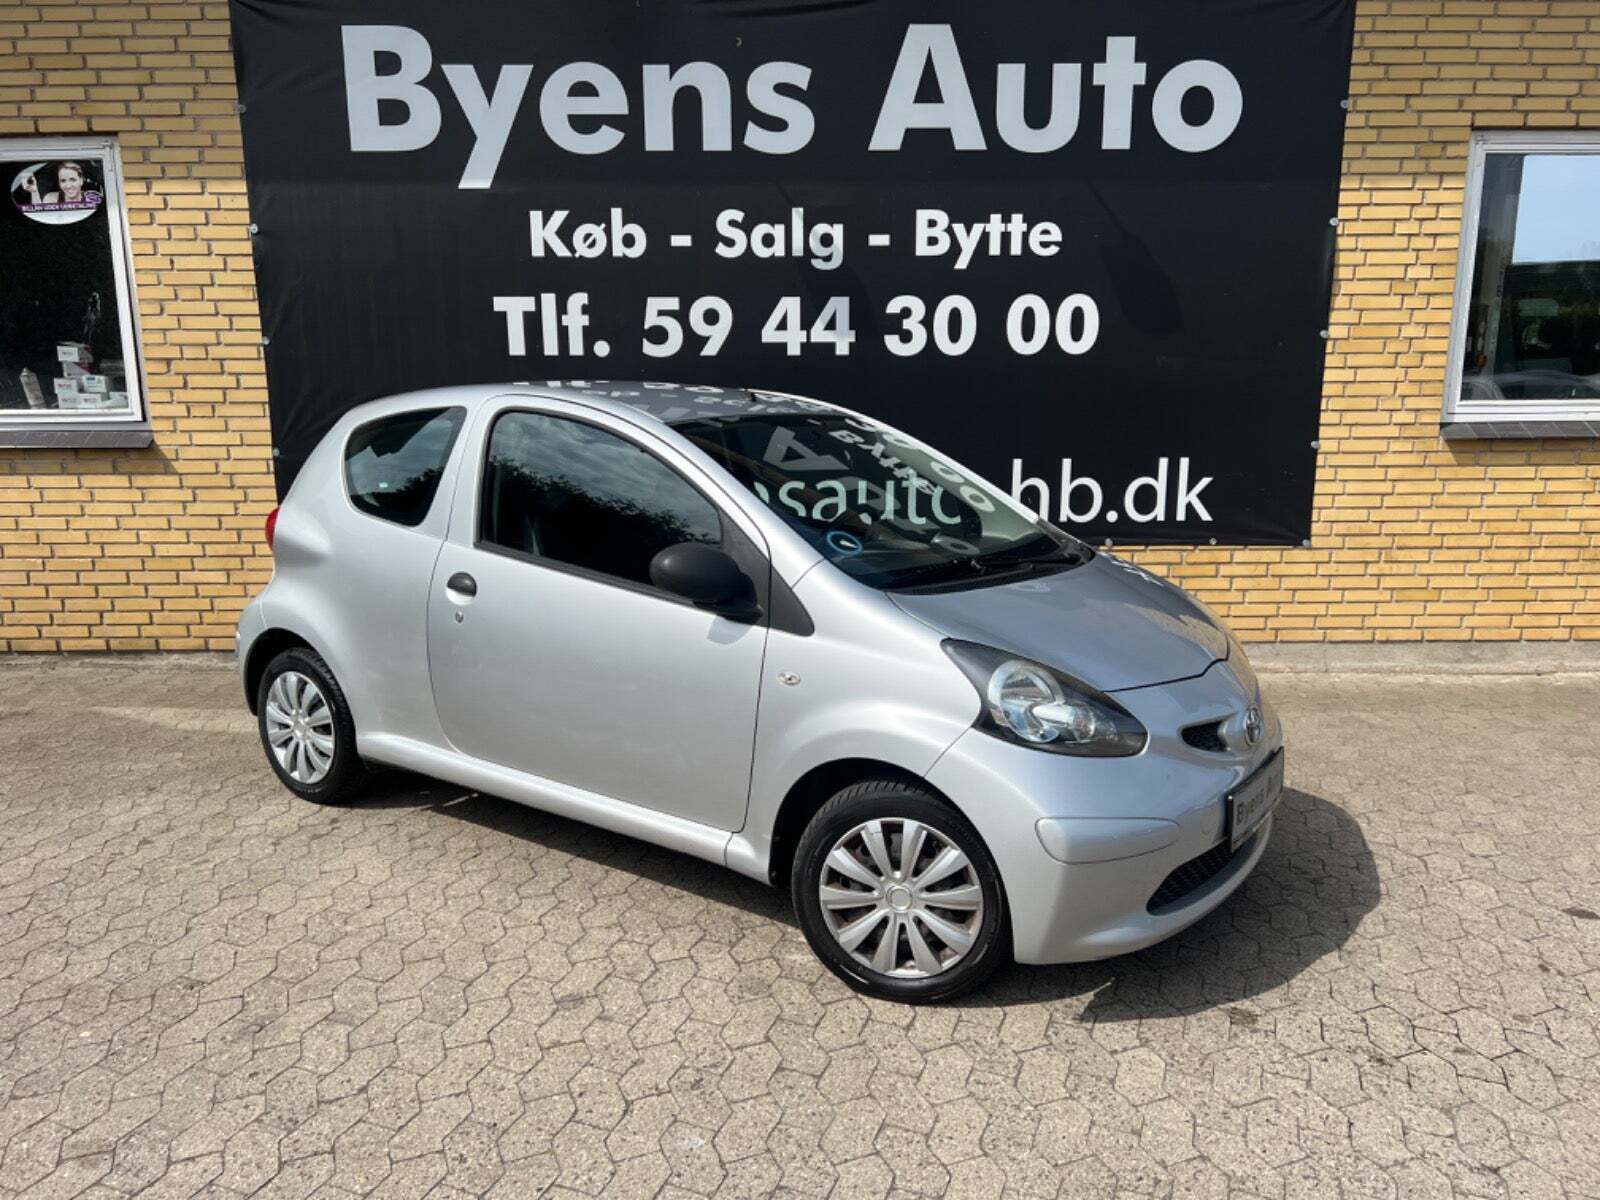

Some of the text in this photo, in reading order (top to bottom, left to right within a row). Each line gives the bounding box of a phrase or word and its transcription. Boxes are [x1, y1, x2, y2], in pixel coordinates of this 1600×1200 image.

[341, 23, 1243, 190] Byens Auto
[529, 207, 1063, 271] Køb - Salg - Bytte
[492, 291, 1100, 358] Tlf. 59 44 30 00
